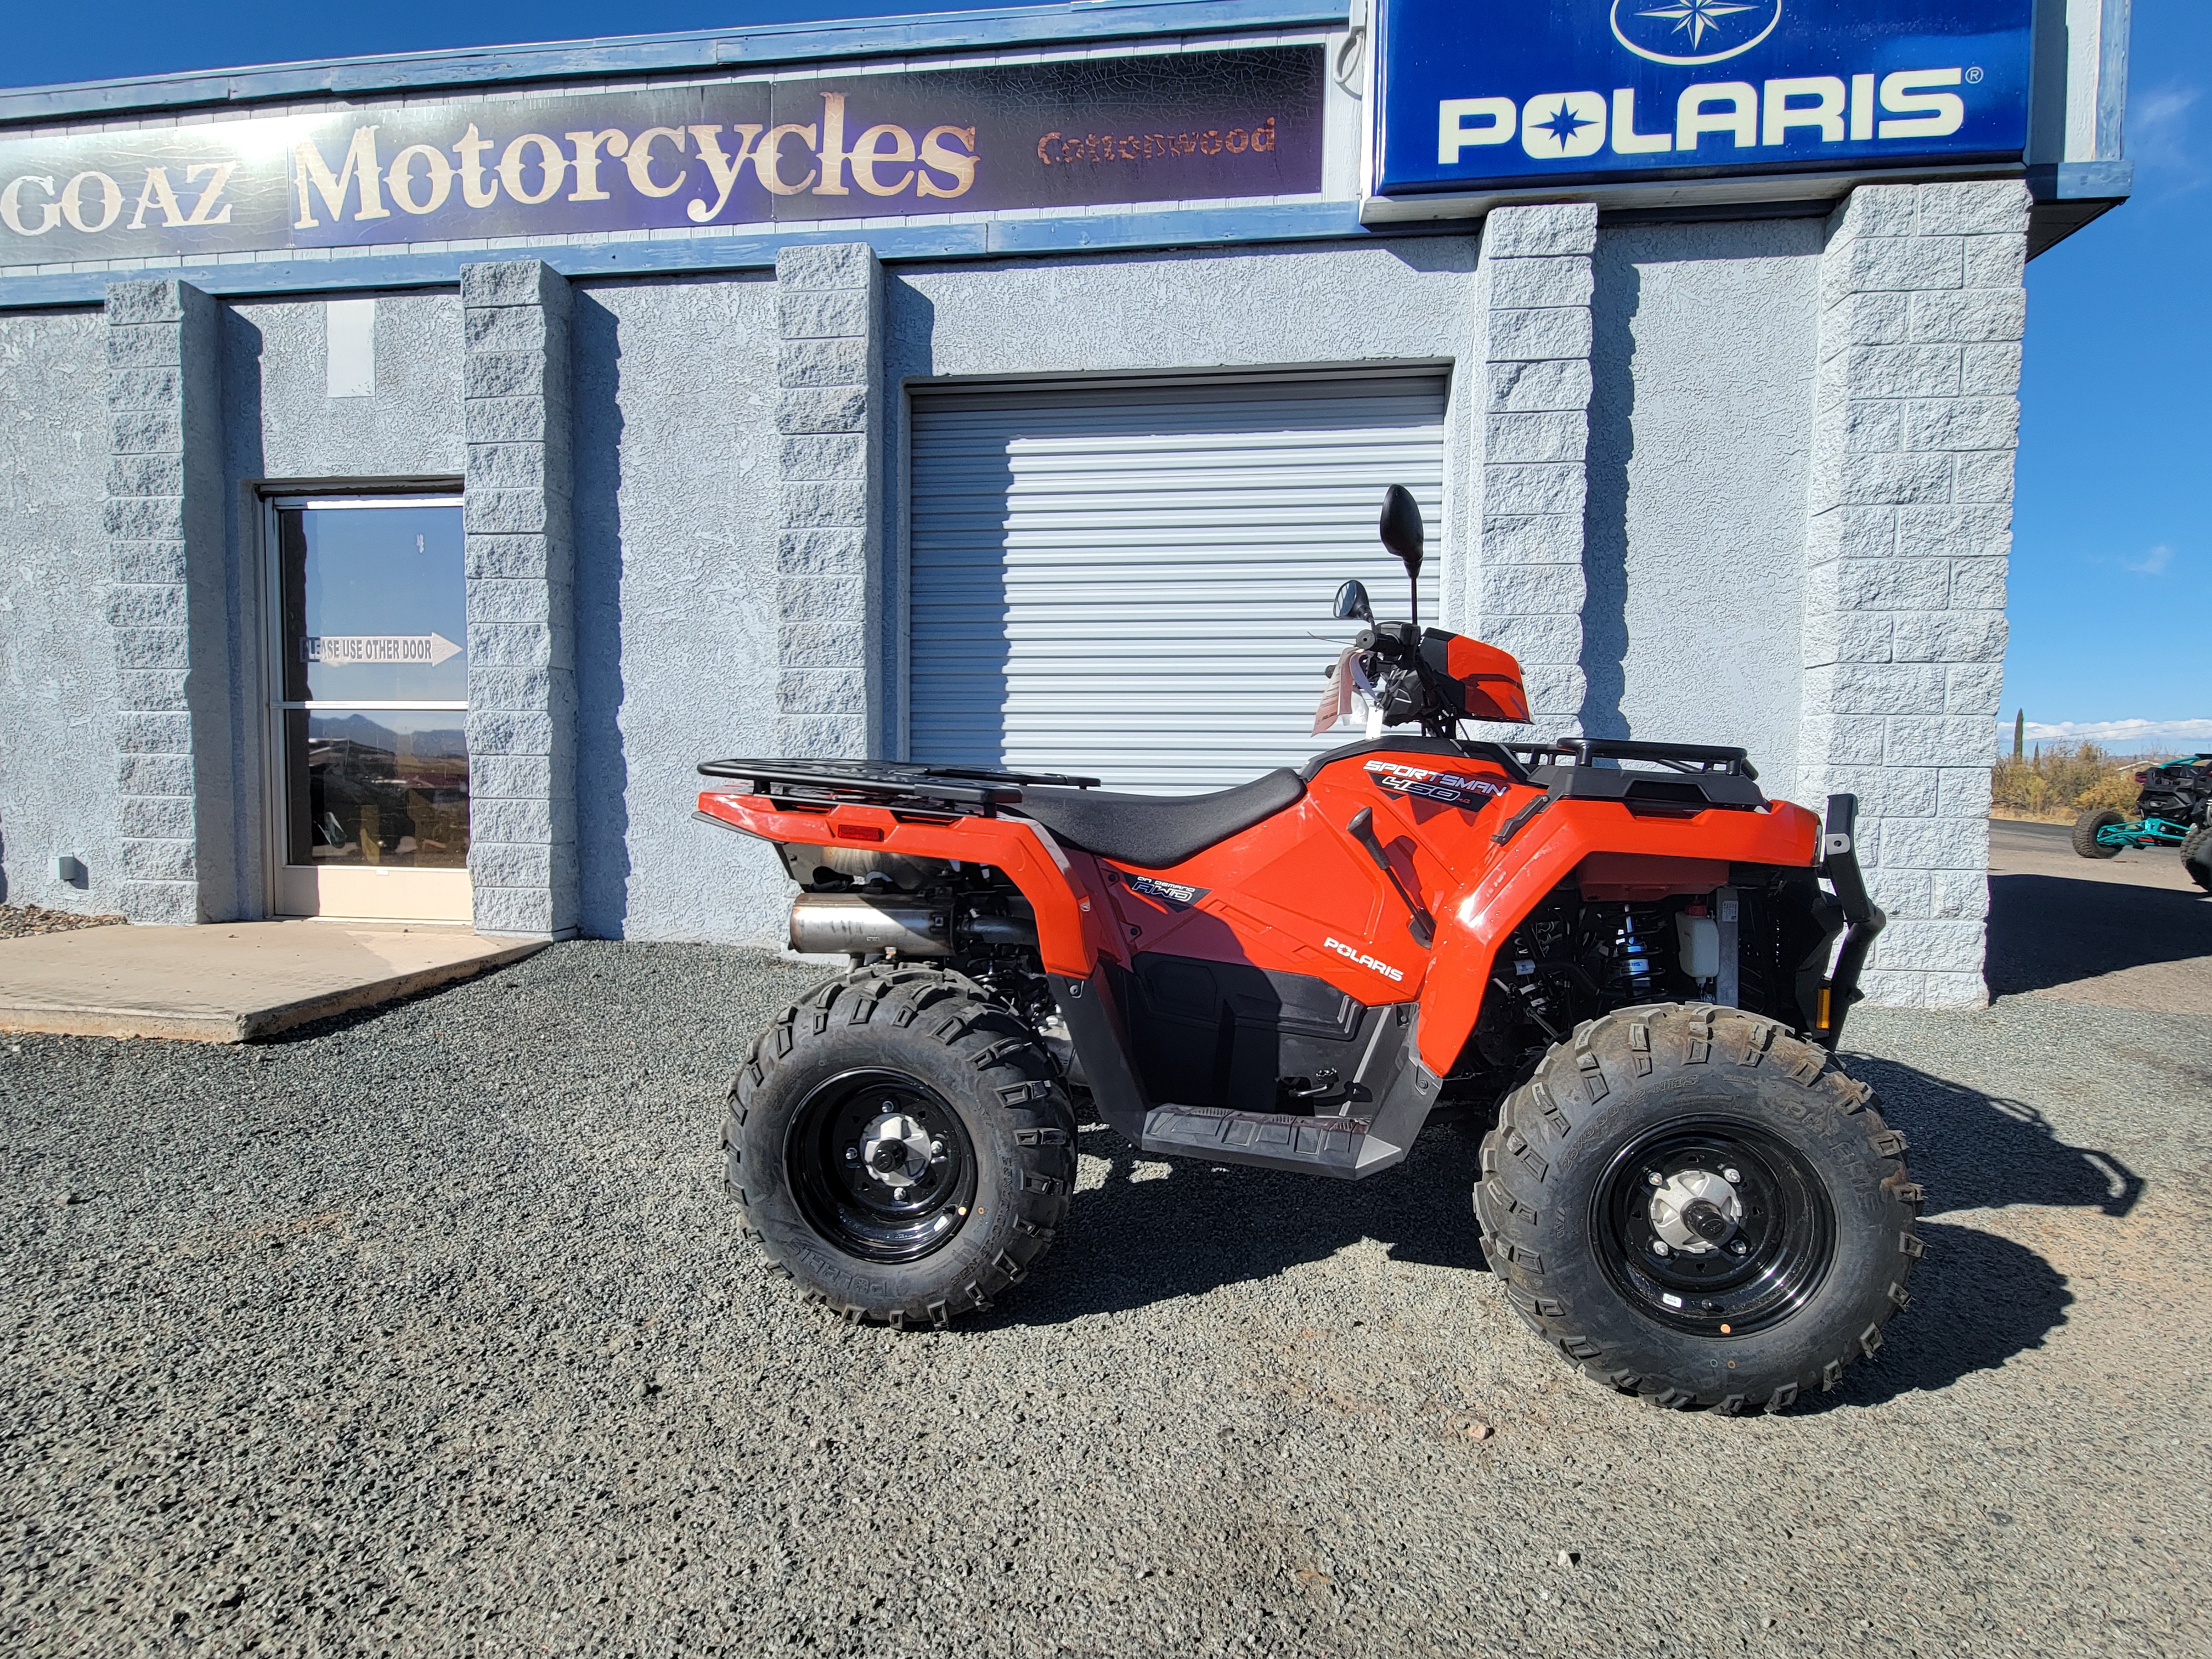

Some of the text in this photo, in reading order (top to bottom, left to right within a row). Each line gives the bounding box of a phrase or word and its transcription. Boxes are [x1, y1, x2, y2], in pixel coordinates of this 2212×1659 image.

[1037, 117, 1276, 165] Cottonwood
[292, 91, 981, 229] Motorcycles
[301, 639, 432, 659] PLEASE USE OTHER DOOR
[1363, 760, 1506, 797] SPORTSMAN
[1382, 776, 1461, 801] 450
[1131, 881, 1193, 902] AWD
[1154, 880, 1196, 893] DEMAND
[1323, 936, 1404, 981] POLARIS
[1653, 1075, 1698, 1093] NHS
